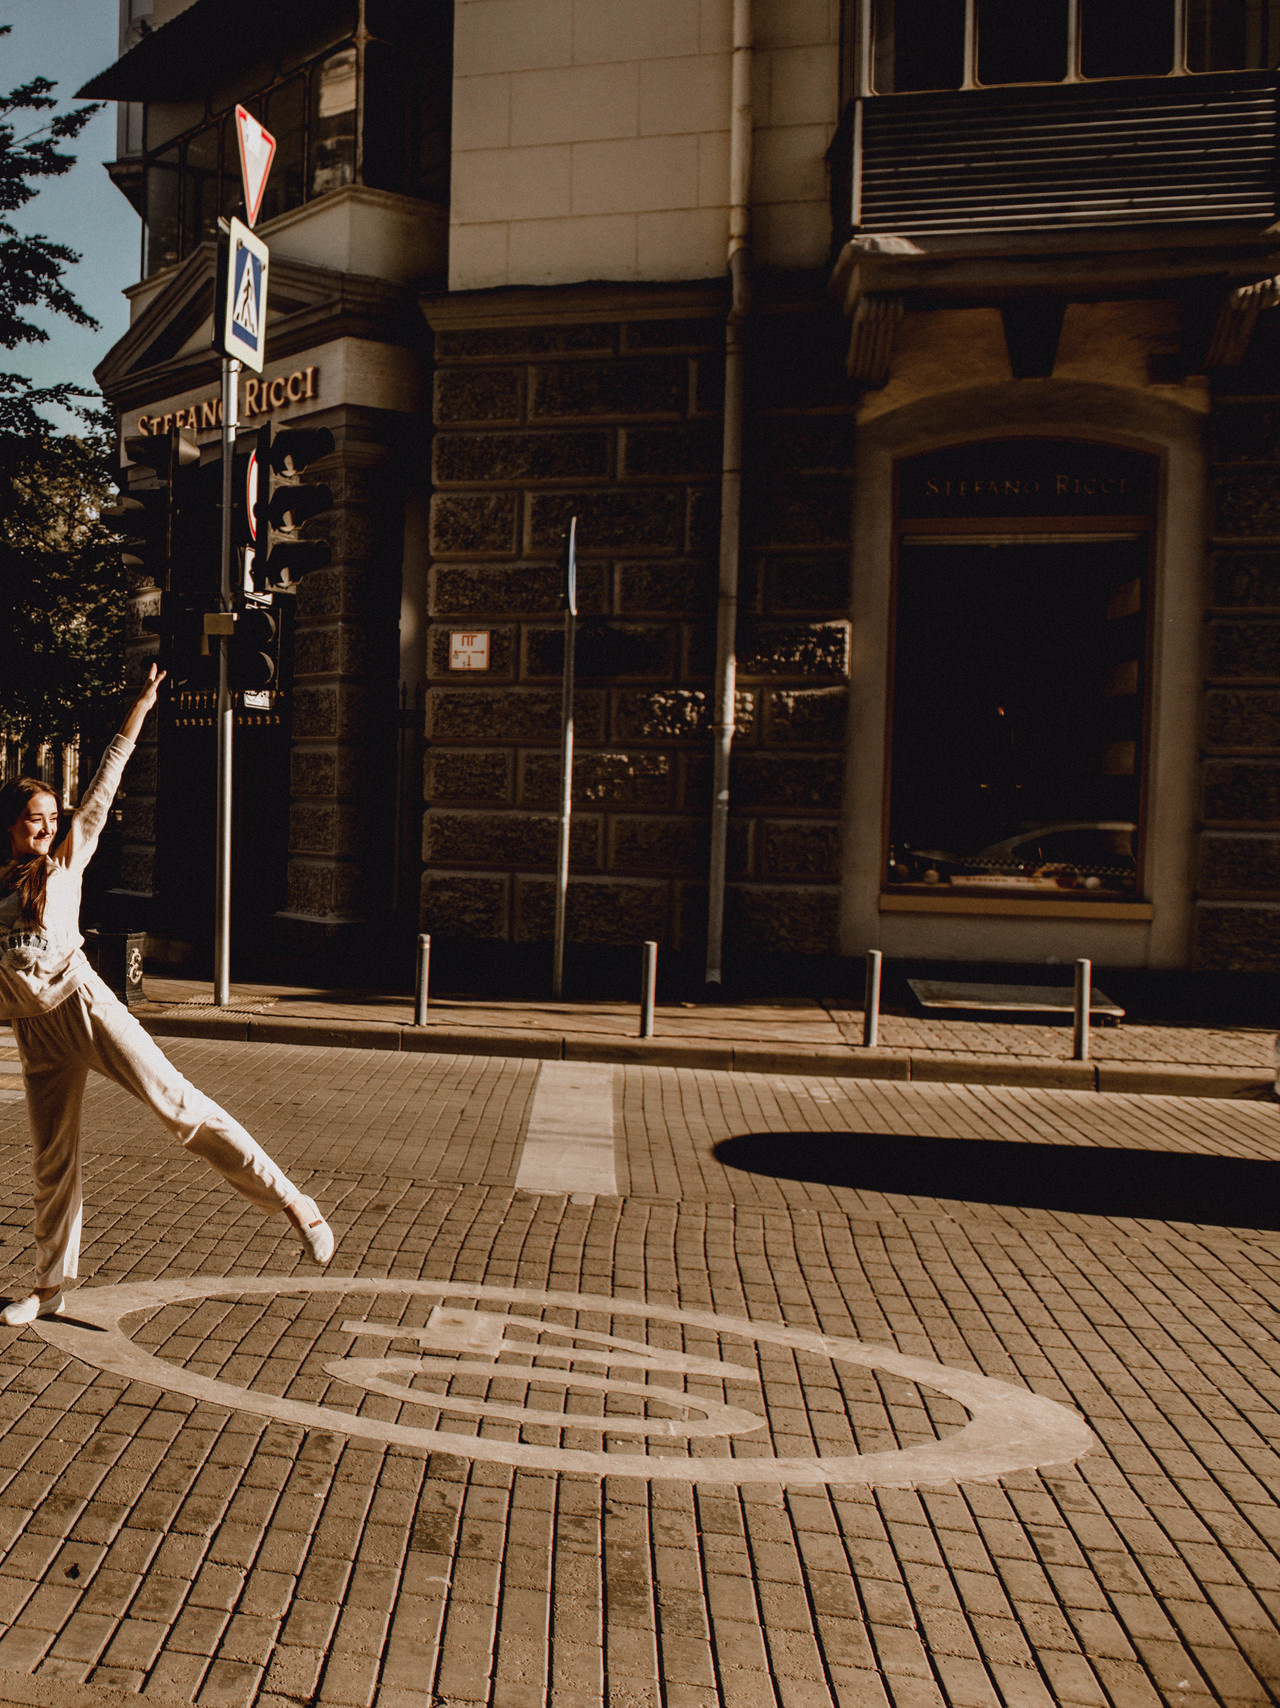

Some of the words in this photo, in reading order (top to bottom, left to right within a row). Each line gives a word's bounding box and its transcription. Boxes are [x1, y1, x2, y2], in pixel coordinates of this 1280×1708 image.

[137, 398, 223, 437] STEFAN
[244, 366, 318, 417] RICCI
[925, 476, 1041, 497] STEFANO
[1055, 474, 1126, 496] RICCI
[461, 635, 478, 647] ПГ
